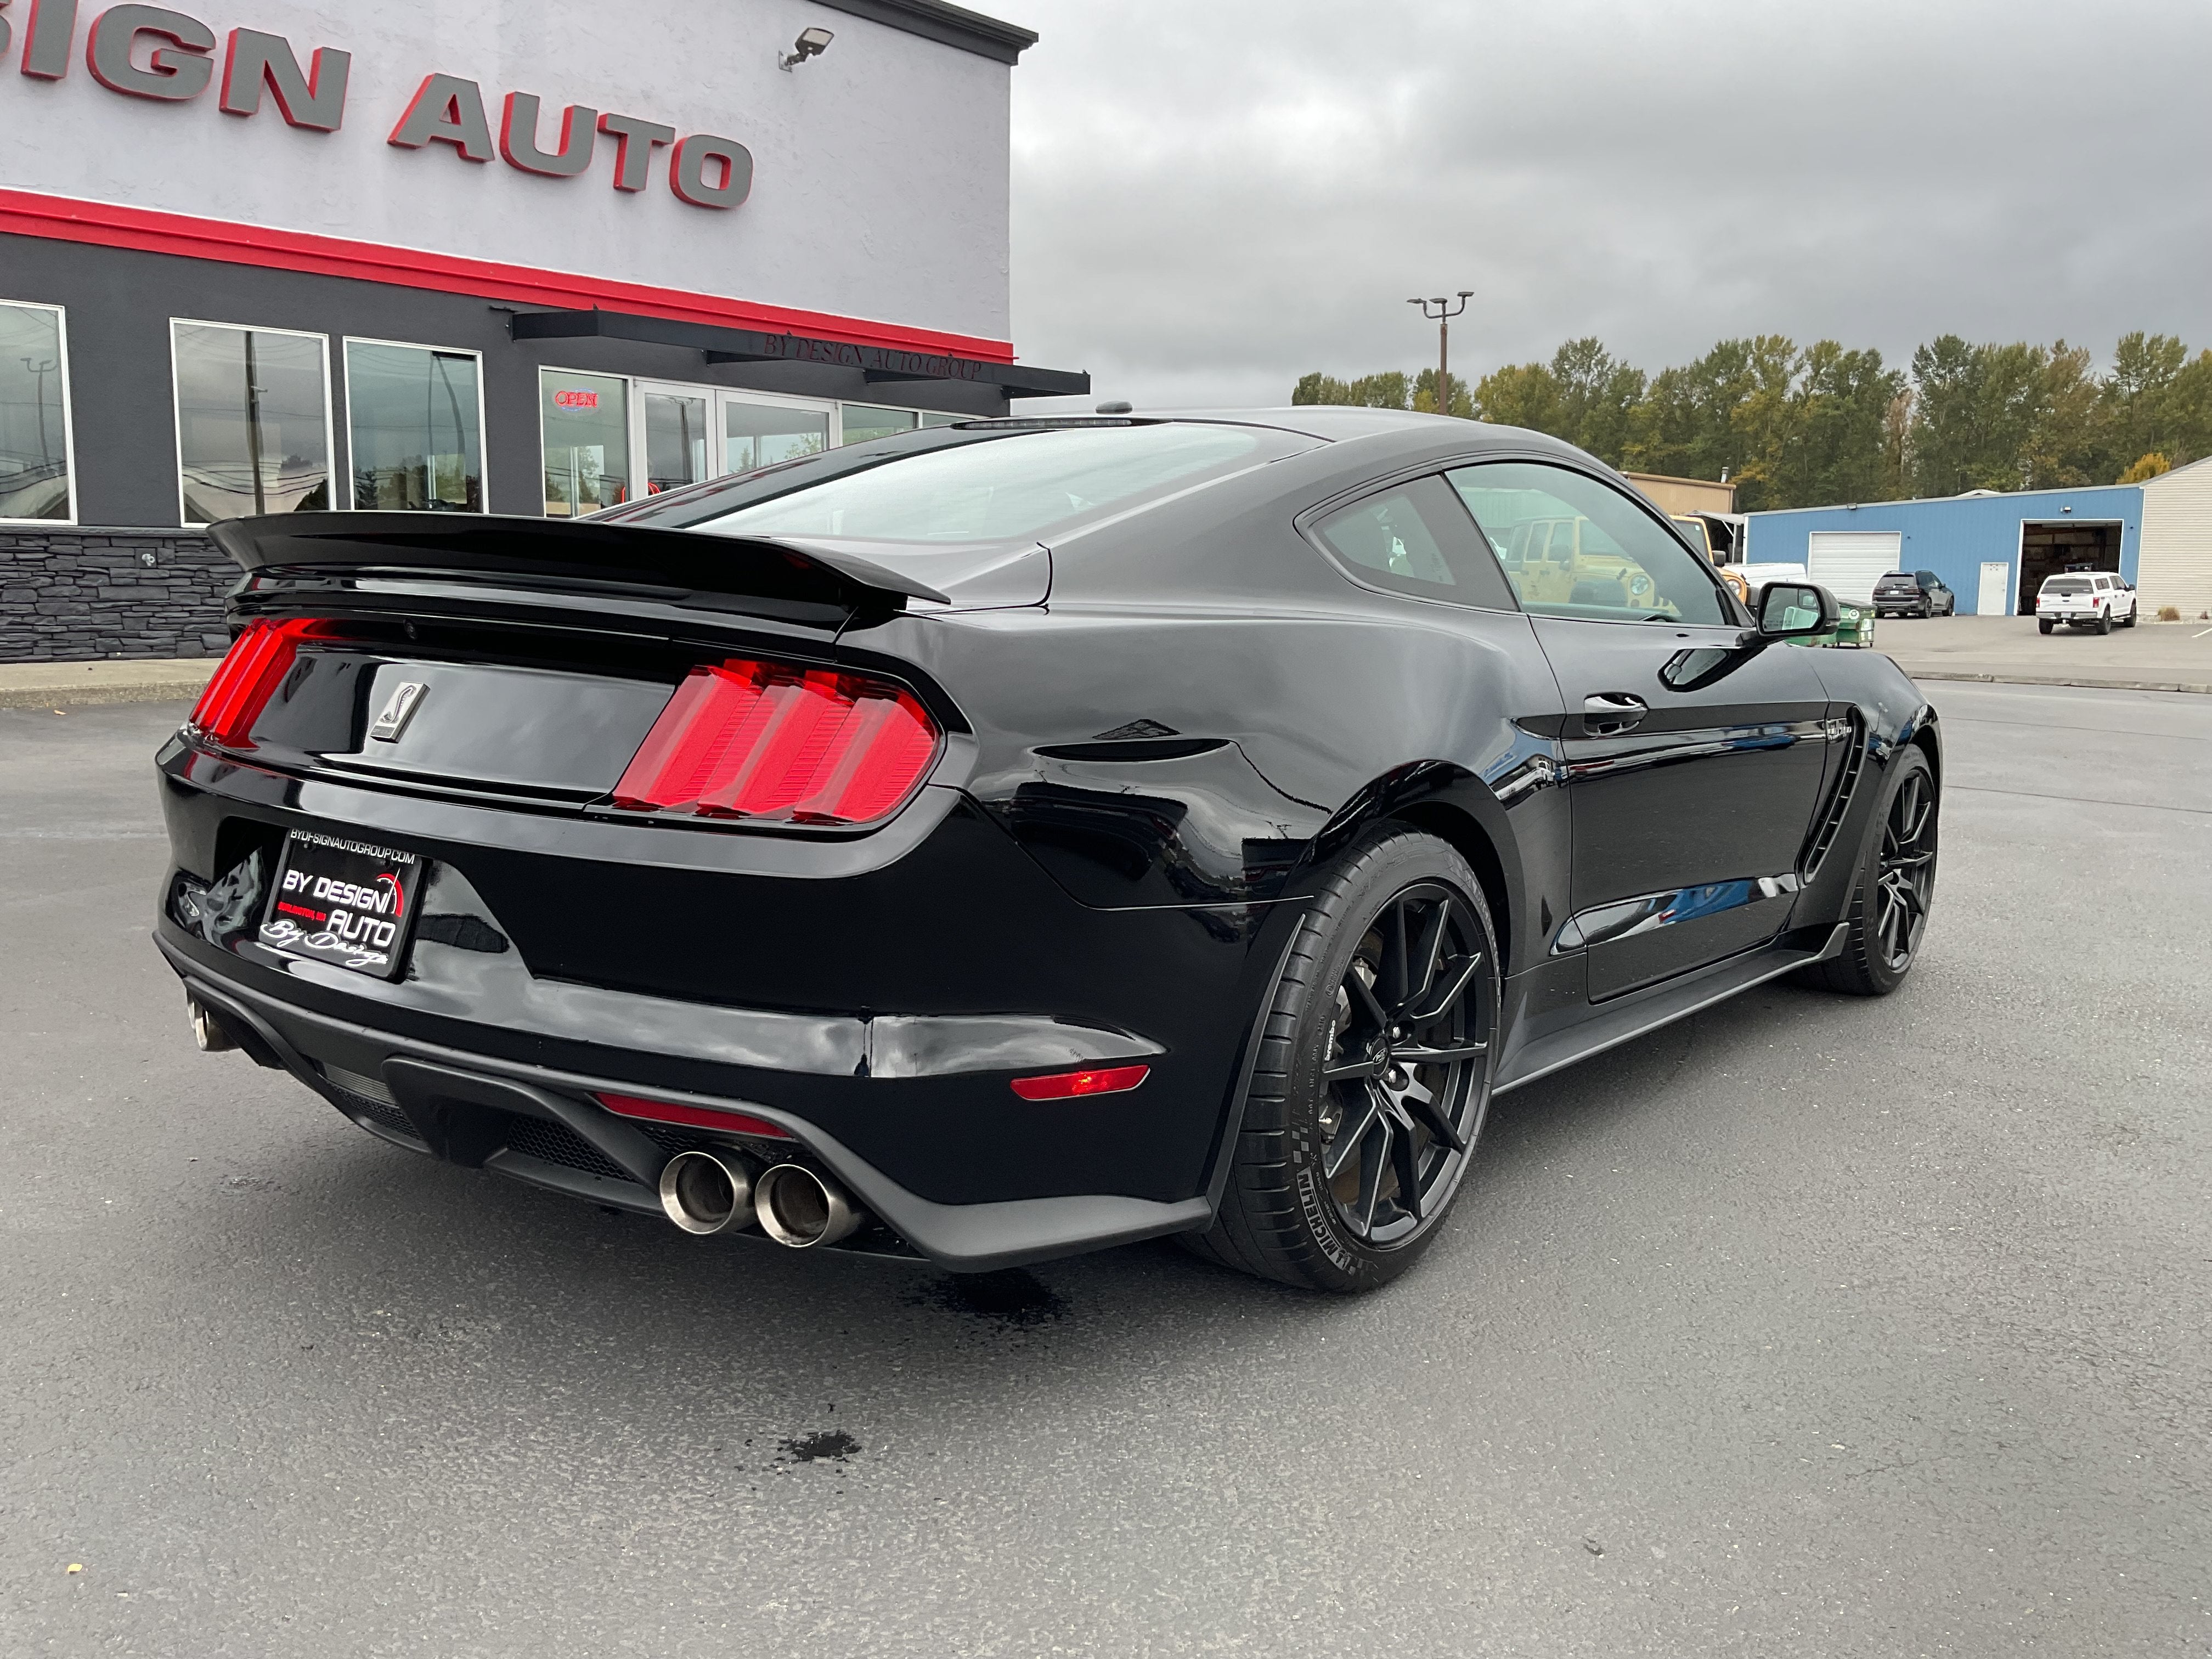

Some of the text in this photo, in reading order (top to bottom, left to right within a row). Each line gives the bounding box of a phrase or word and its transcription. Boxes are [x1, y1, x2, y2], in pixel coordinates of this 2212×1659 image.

[0, 0, 753, 208] IGN AUTO
[764, 335, 981, 380] BY DESIGN AUTO GROUP
[555, 391, 597, 408] OPEN
[290, 828, 415, 865] BYDSIGNAUTOGROUPCOM
[283, 869, 390, 913] BY DESIGN
[260, 920, 304, 947] By
[326, 909, 396, 947] AUTO
[1324, 1019, 1336, 1061] brembo
[1297, 1173, 1339, 1257] MICHELIN
